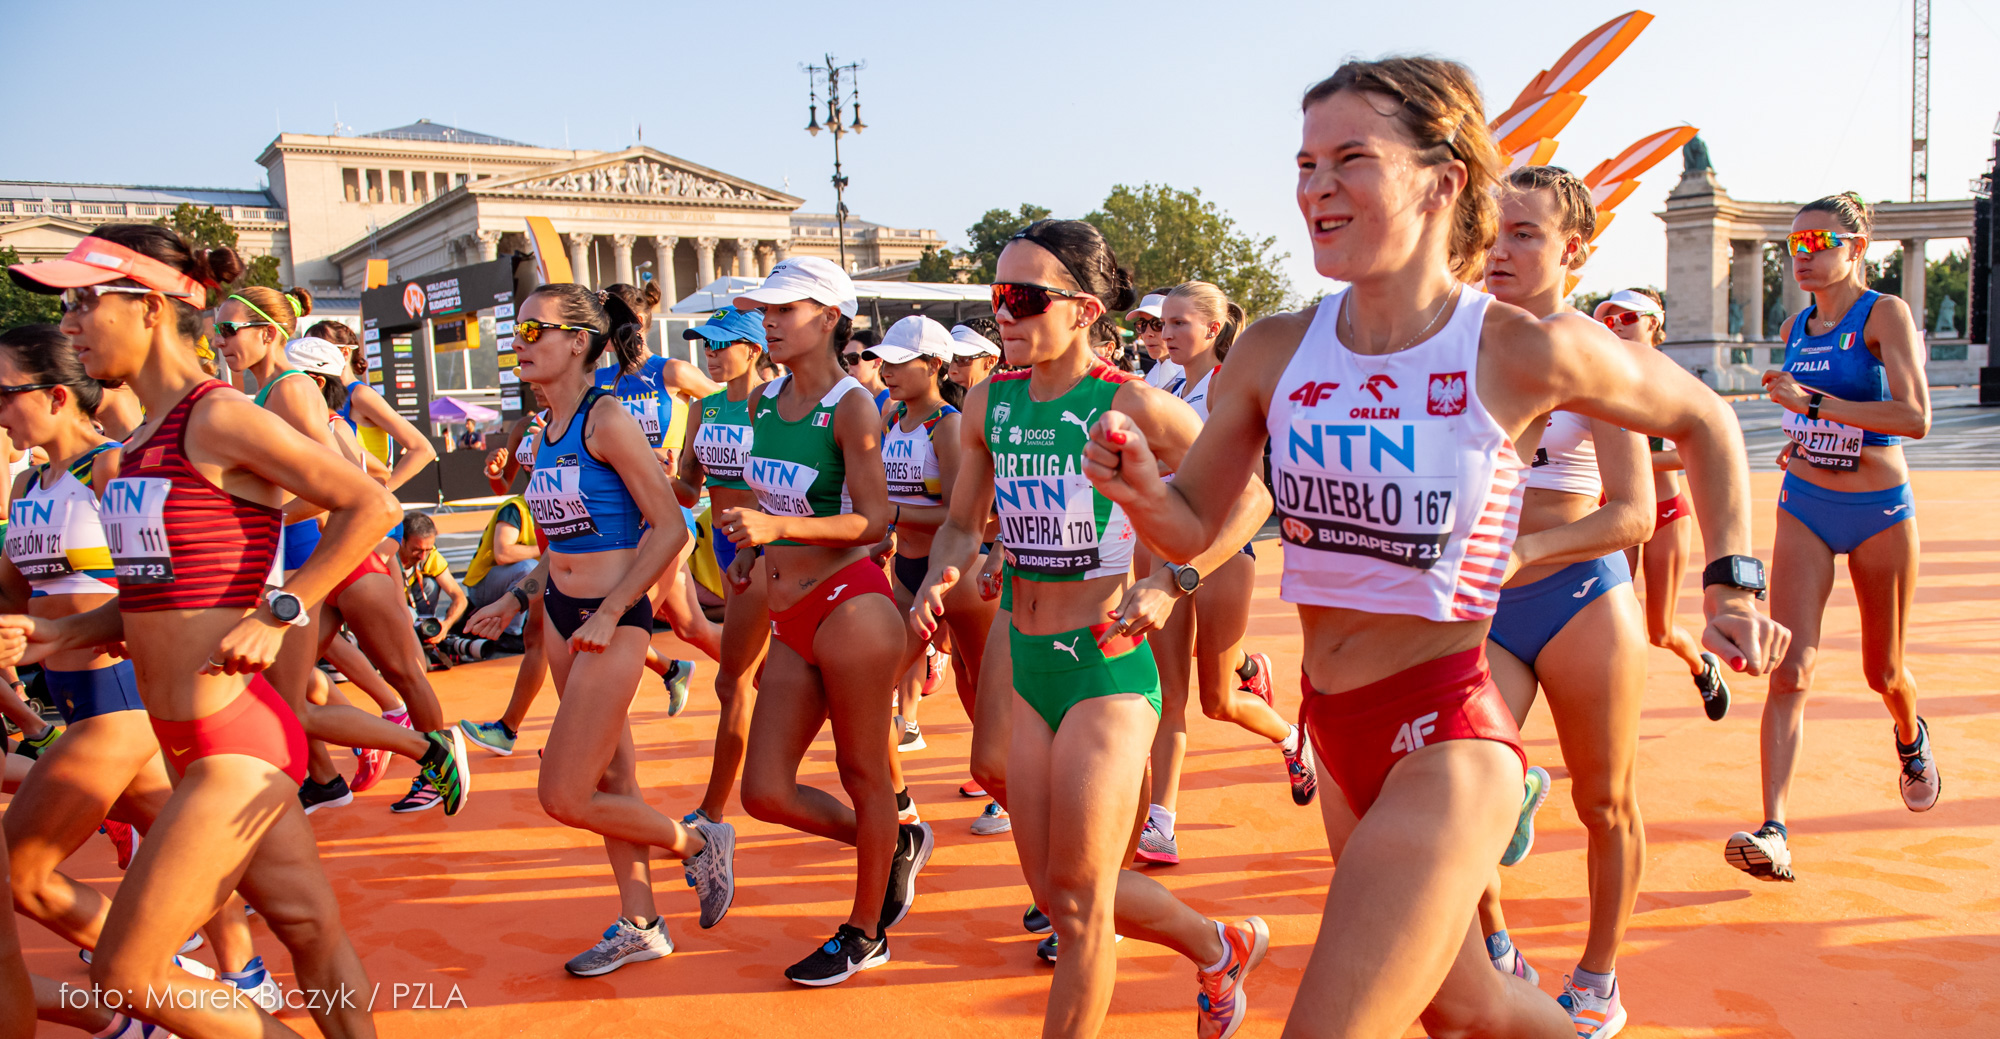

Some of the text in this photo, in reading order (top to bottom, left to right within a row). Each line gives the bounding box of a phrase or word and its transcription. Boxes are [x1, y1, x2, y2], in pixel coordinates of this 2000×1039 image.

[1790, 360, 1830, 372] ITALIA
[1289, 381, 1340, 407] 4F
[1349, 407, 1400, 420] ORLEN
[646, 420, 659, 432] 178
[703, 425, 743, 445] NTN
[1023, 429, 1056, 443] JOGOS
[1841, 437, 1860, 453] 146
[695, 445, 705, 462] DE
[706, 446, 737, 464] SOUSA
[886, 440, 913, 458] NTN
[1289, 424, 1415, 473] NTN
[1840, 459, 1853, 467] 23
[530, 469, 563, 494] NTN
[709, 468, 743, 477] BUDAPEST
[752, 460, 799, 488] NTN
[911, 466, 921, 480] 123
[102, 481, 146, 514] NTN
[887, 485, 913, 493] UDAPEST
[995, 479, 1066, 511] NTN
[10, 499, 54, 528] NTN
[566, 500, 586, 516] 115
[792, 497, 809, 514] 161
[1413, 491, 1452, 525] 167
[542, 521, 591, 536] UDAPEST 23
[1067, 520, 1093, 545] 170
[47, 533, 61, 554] 121
[104, 522, 164, 554] LIU 111
[1318, 528, 1442, 560] BUDAPEST 23
[49, 563, 65, 573] 23
[146, 564, 166, 576] 23
[1019, 554, 1092, 568] BUDAPEST 23
[1391, 711, 1438, 753] 4F
